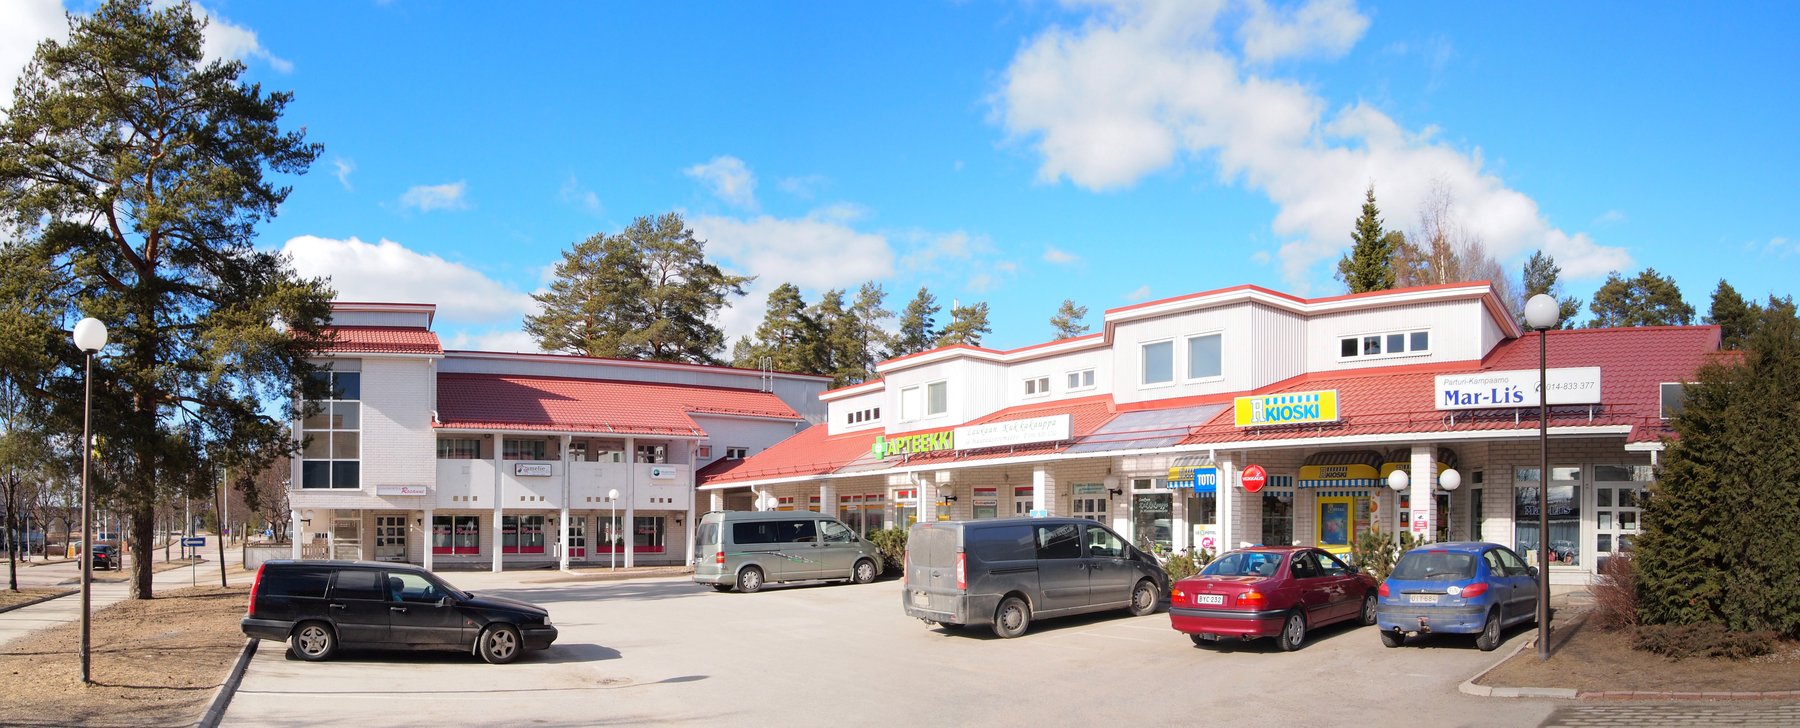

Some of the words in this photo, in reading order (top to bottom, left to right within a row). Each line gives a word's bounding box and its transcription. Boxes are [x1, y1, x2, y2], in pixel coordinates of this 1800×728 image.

[1579, 382, 1595, 390] 377
[1265, 403, 1319, 422] KIOSKI
[887, 431, 955, 456] APTEEKKI
[1197, 473, 1215, 486] TOTO
[1199, 595, 1222, 603] BYC-232
